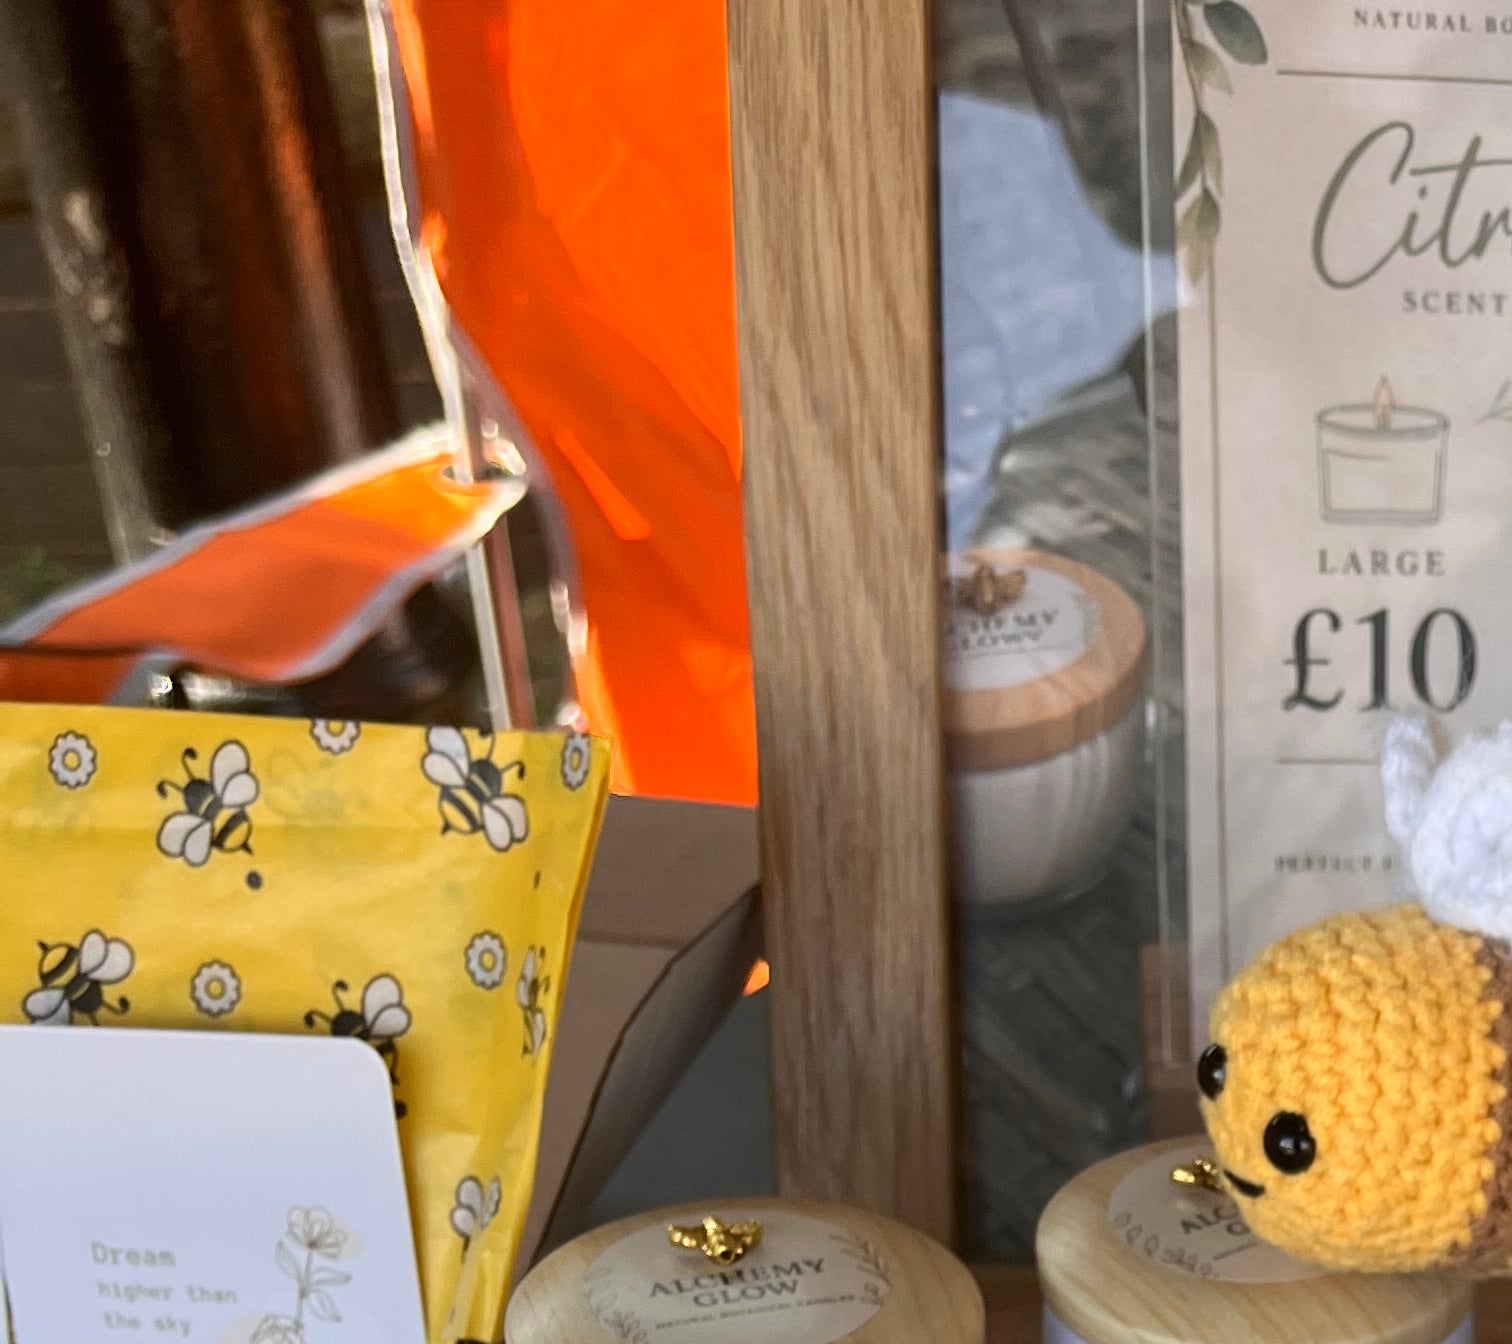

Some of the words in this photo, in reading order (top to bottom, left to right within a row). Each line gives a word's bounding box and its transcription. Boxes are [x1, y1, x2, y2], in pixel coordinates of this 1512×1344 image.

[1353, 9, 1472, 34] NATURAL
[1318, 549, 1446, 577] LARGE
[1281, 608, 1478, 712] £10
[91, 1241, 176, 1267] Dream
[651, 1258, 825, 1298] ALCHEMY
[693, 1279, 799, 1308] GLOW
[103, 1313, 141, 1330] the
[155, 1315, 192, 1338] sky
